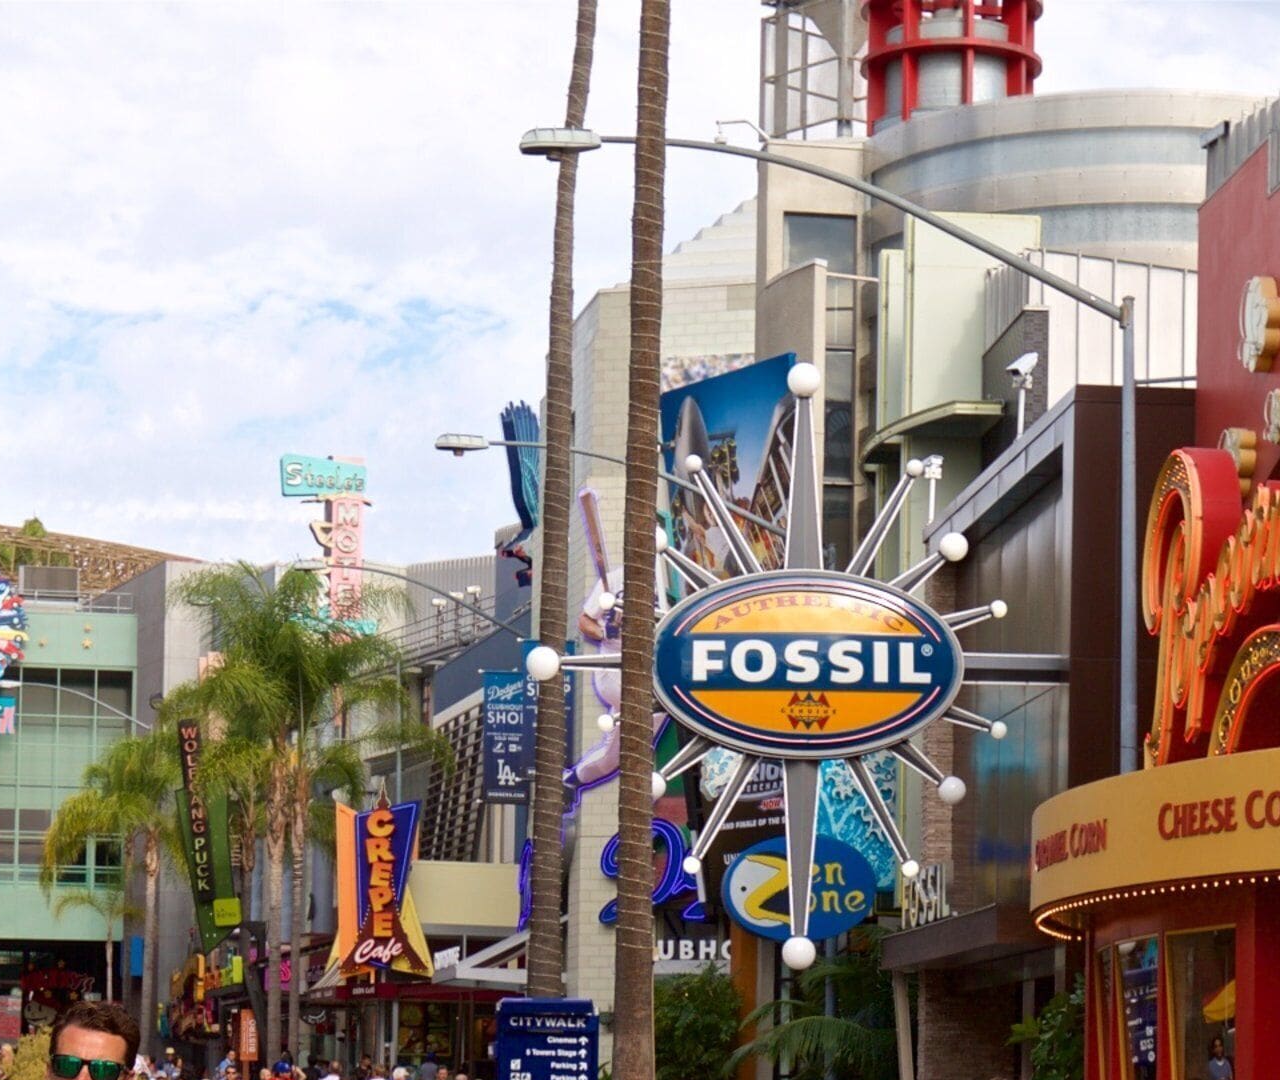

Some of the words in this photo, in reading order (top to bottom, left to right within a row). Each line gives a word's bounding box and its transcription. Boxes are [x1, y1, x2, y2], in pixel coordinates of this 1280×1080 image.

[334, 503, 360, 607] MOTE
[691, 639, 932, 684] FOSSIL
[487, 712, 523, 725] SHO
[1158, 797, 1238, 840] CHEESE
[195, 837, 210, 891] PUCK
[365, 810, 395, 937] CREPE
[354, 938, 403, 964] Cafe
[509, 1016, 587, 1028] CITYWALK
[550, 1061, 577, 1071] Parking
